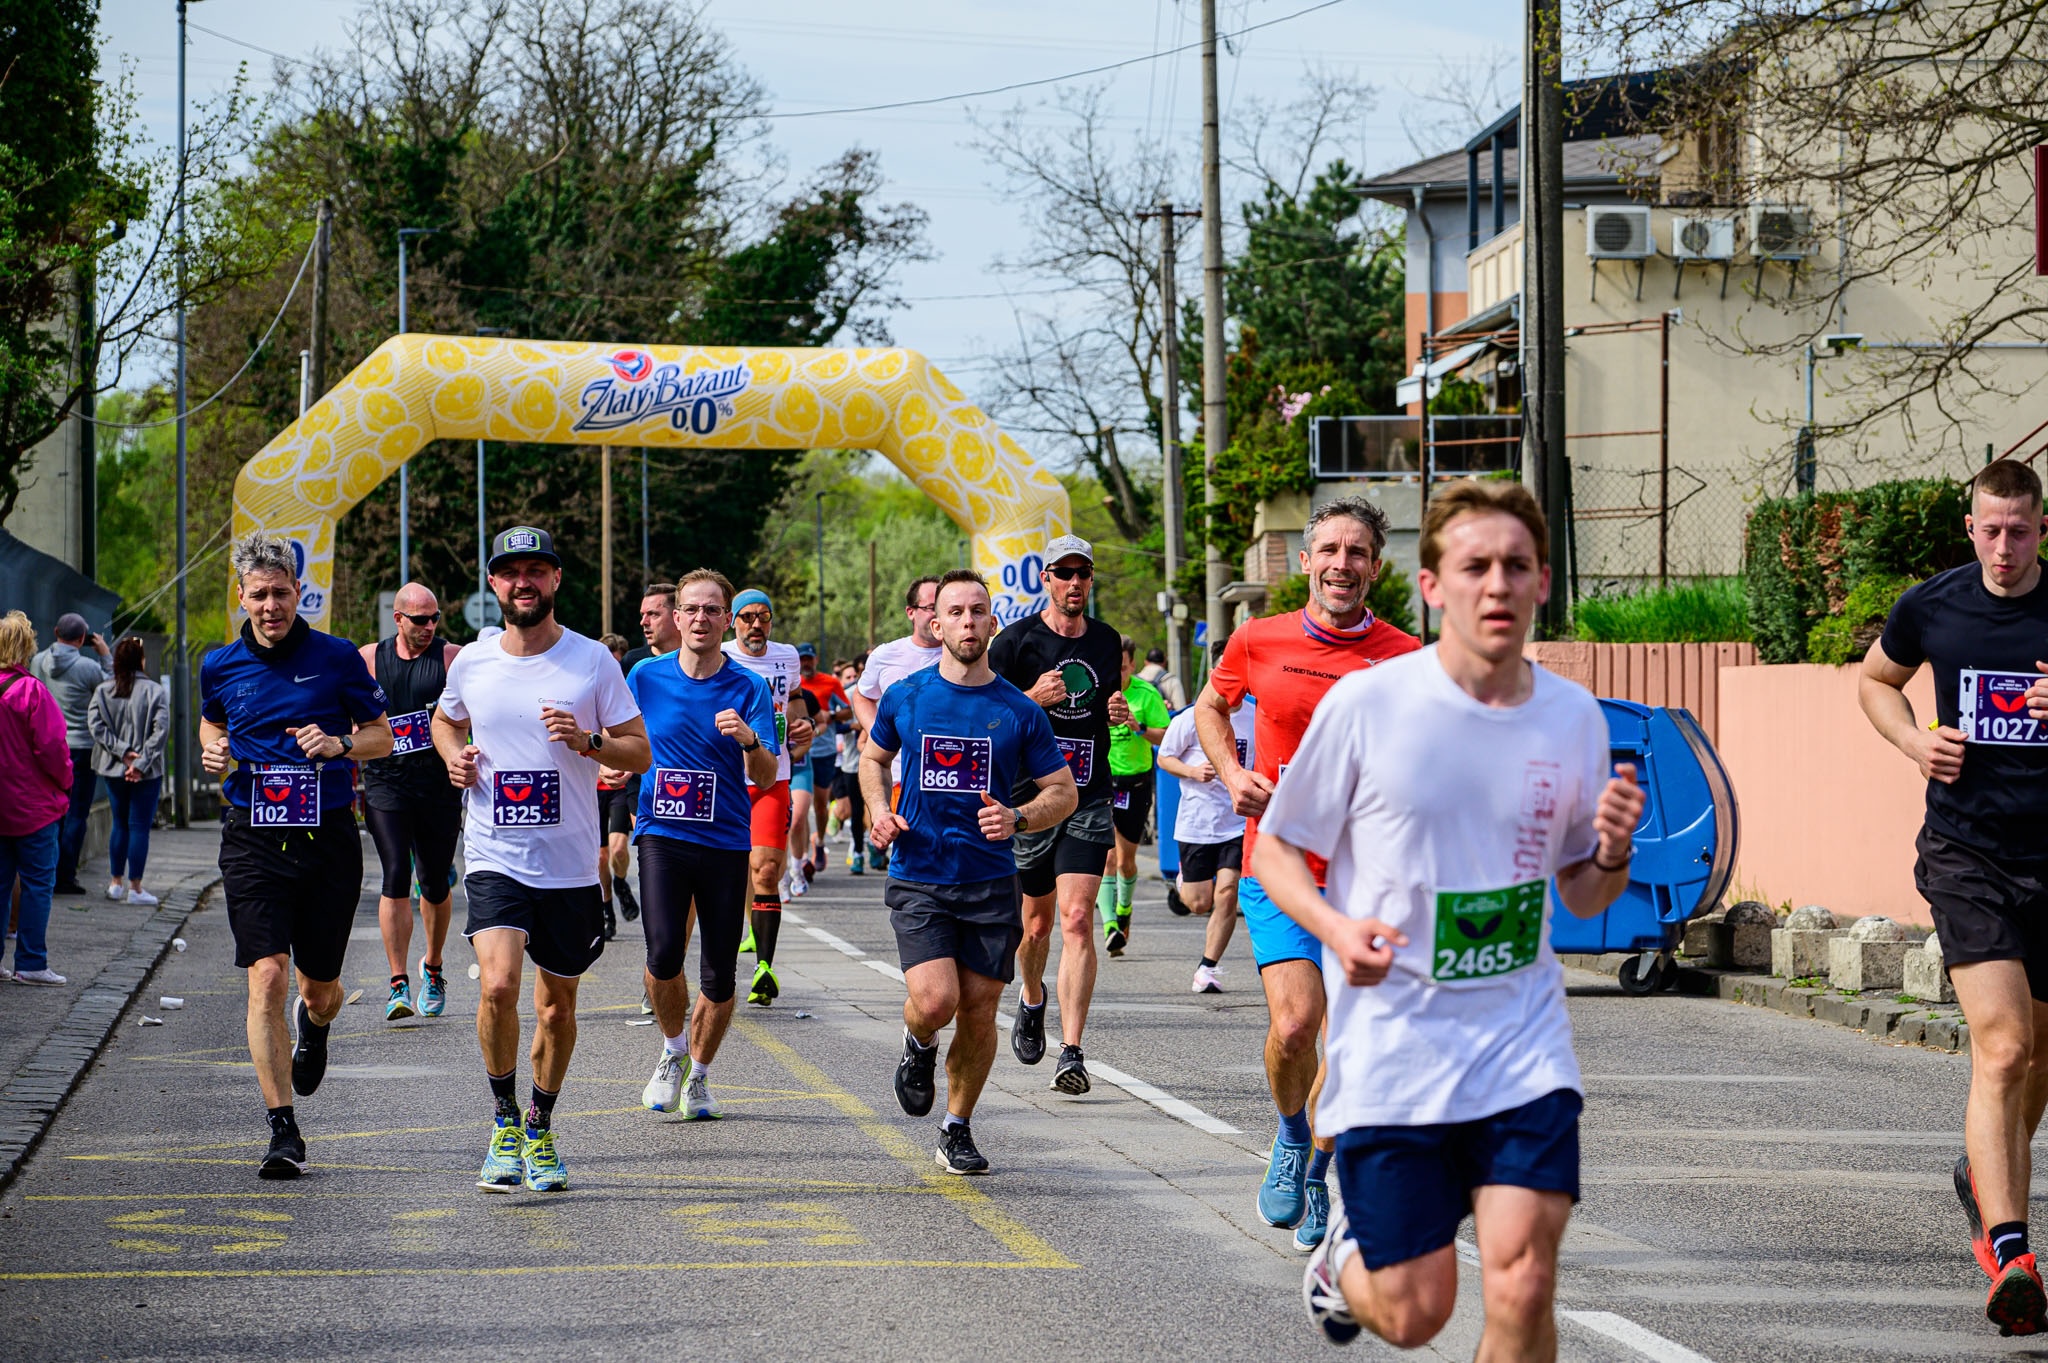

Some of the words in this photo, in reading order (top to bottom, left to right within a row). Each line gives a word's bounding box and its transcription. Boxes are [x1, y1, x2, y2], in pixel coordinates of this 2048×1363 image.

[573, 379, 655, 431] Zlatý
[655, 364, 747, 406] Bažant
[511, 534, 534, 546] SEATTLE
[1282, 665, 1341, 681] SCHEIDT&BACHMA
[1978, 716, 2039, 740] 1027
[923, 769, 959, 788] 866
[255, 805, 289, 823] 102
[495, 805, 542, 824] 1325
[655, 799, 686, 816] 520
[1435, 941, 1515, 978] 2465
